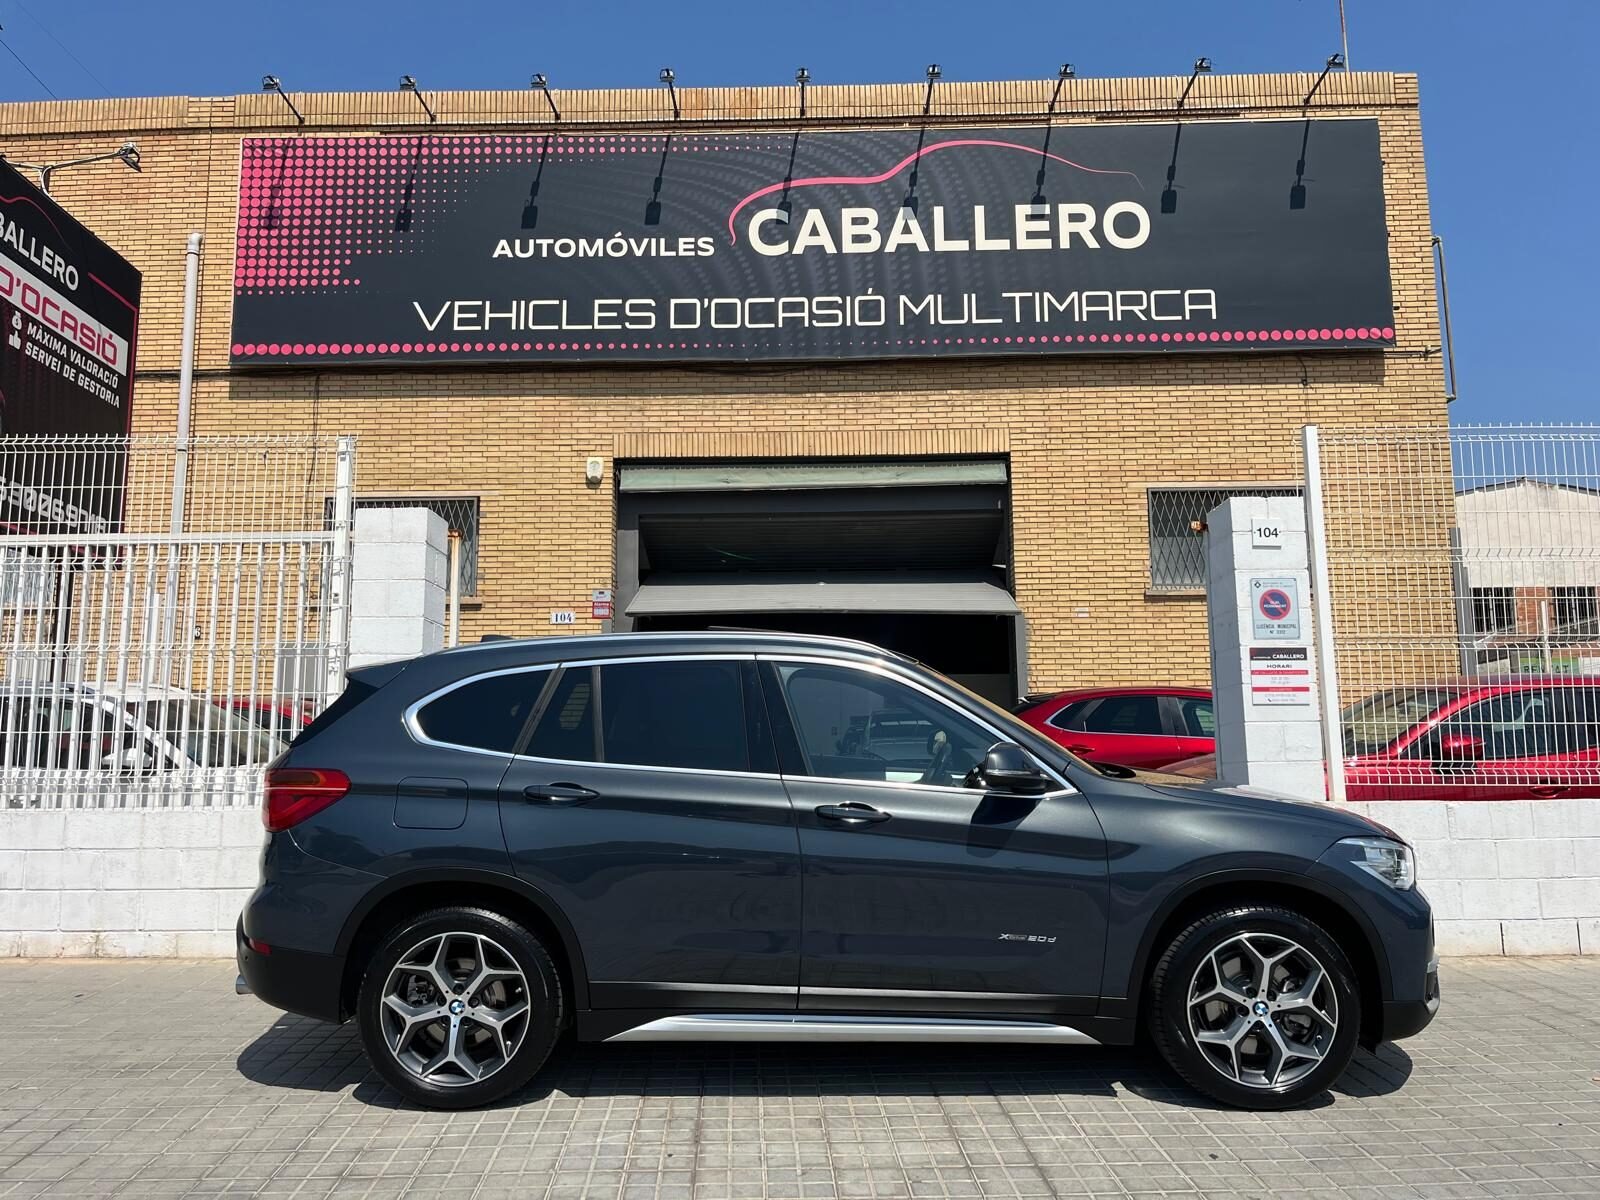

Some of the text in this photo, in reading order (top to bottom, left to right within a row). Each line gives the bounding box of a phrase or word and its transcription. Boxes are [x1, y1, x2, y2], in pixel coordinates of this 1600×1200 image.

[493, 201, 1151, 258] AUTOMÓVILES CABALLERO
[413, 287, 1217, 331] VEHICLES D'OCASIÓ MULTIMARCA
[25, 342, 120, 409] SERVEI DE GESTORIA
[70, 348, 119, 389] VALORACIÓ
[1256, 527, 1279, 538] 104
[555, 613, 572, 623] 104
[1523, 665, 1569, 674] RENAT
